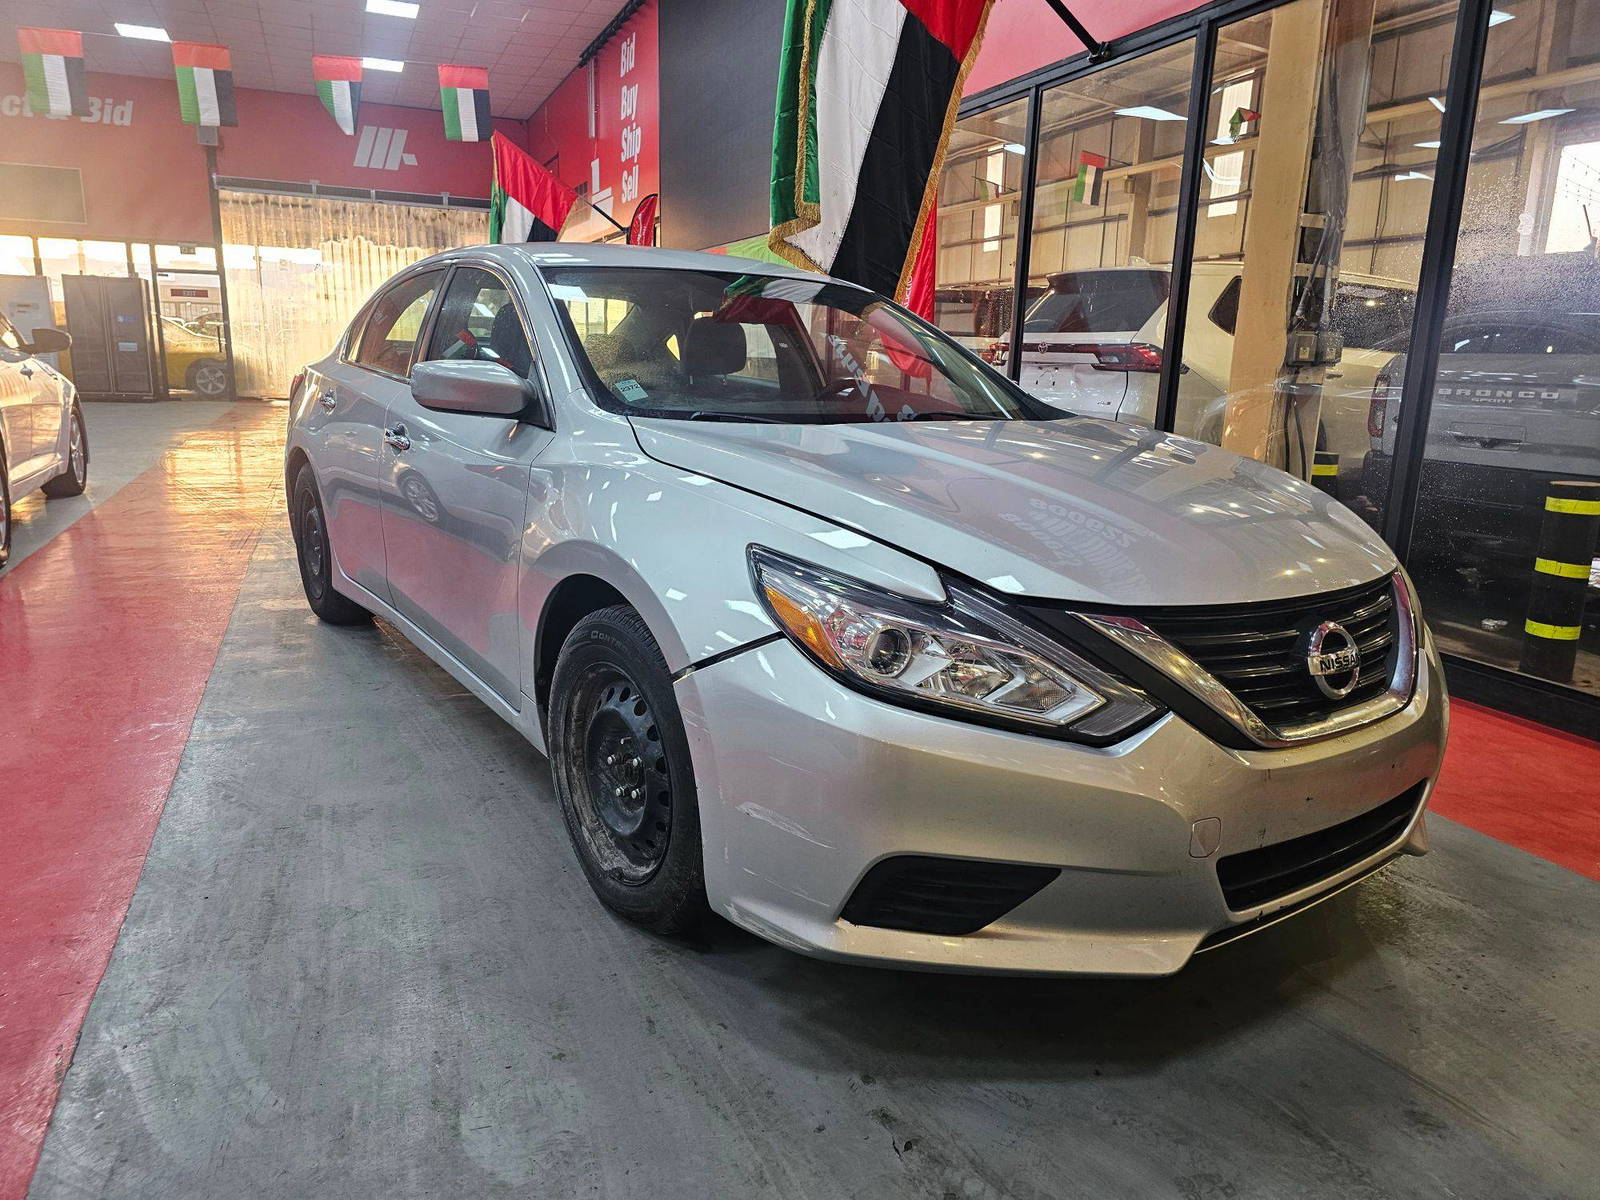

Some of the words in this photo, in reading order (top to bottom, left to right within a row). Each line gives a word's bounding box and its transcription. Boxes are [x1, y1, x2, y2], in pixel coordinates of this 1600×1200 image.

[620, 32, 636, 78] Bid
[80, 96, 134, 126] Bid
[620, 83, 639, 121] Buy
[620, 122, 641, 163] Ship
[621, 164, 639, 203] Sell
[1438, 388, 1560, 400] BRONCO
